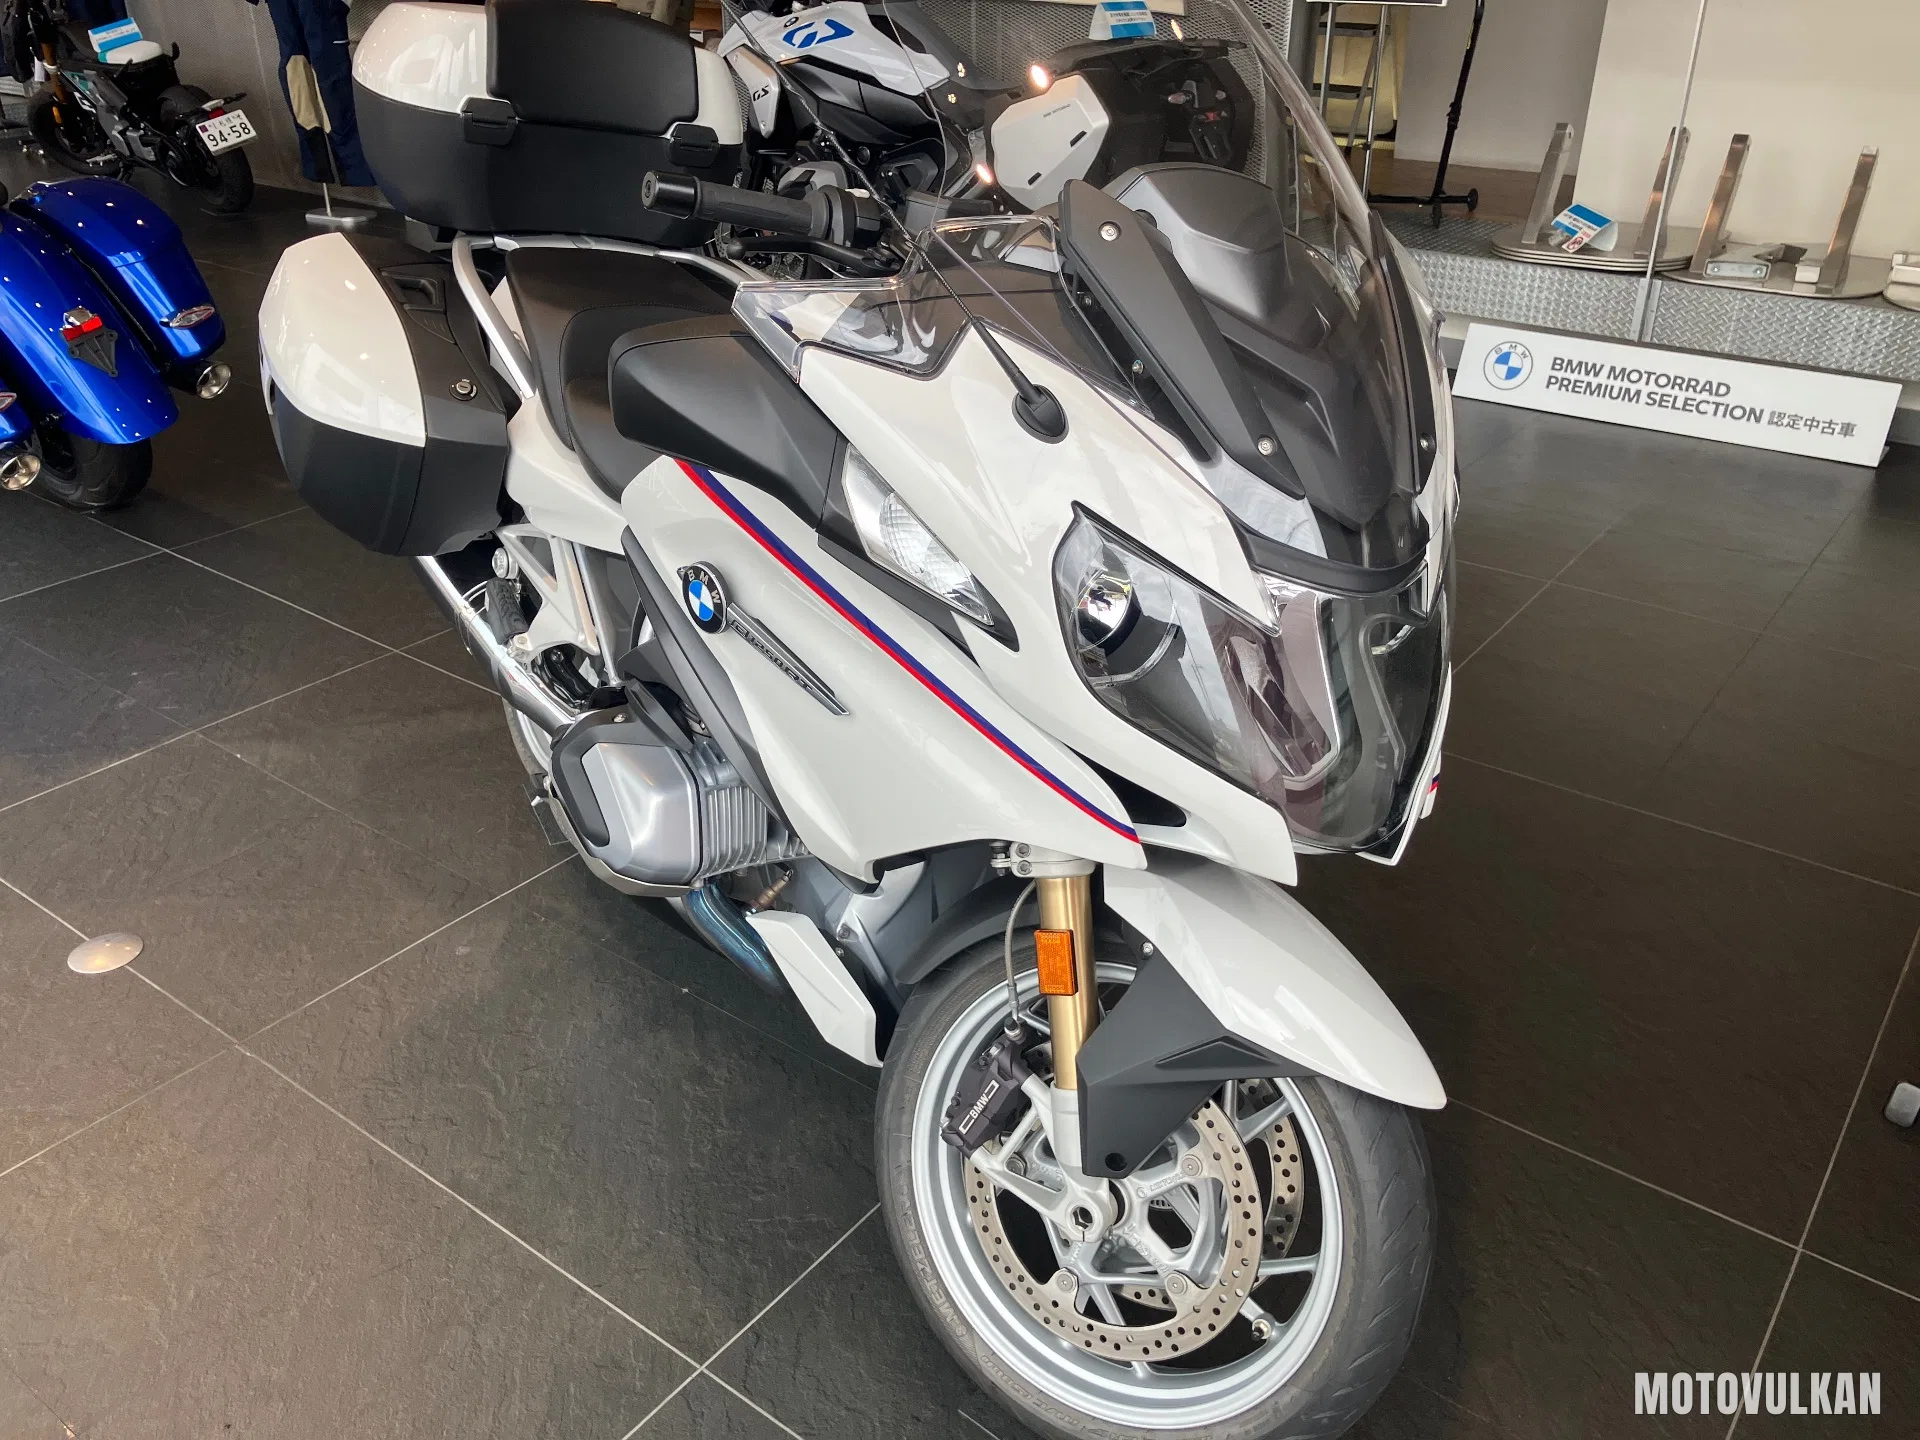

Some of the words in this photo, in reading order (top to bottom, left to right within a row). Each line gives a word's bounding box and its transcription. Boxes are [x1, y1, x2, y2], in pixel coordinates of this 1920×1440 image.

[752, 84, 770, 102] GS
[207, 122, 251, 147] 94-58
[1551, 356, 1604, 377] BMW
[1606, 365, 1732, 397] MOTORRAD
[1545, 375, 1642, 404] PREMIUM
[1644, 391, 1764, 424] SELECTION
[1767, 410, 1857, 439] 認定中古車
[969, 1092, 990, 1120] BMW
